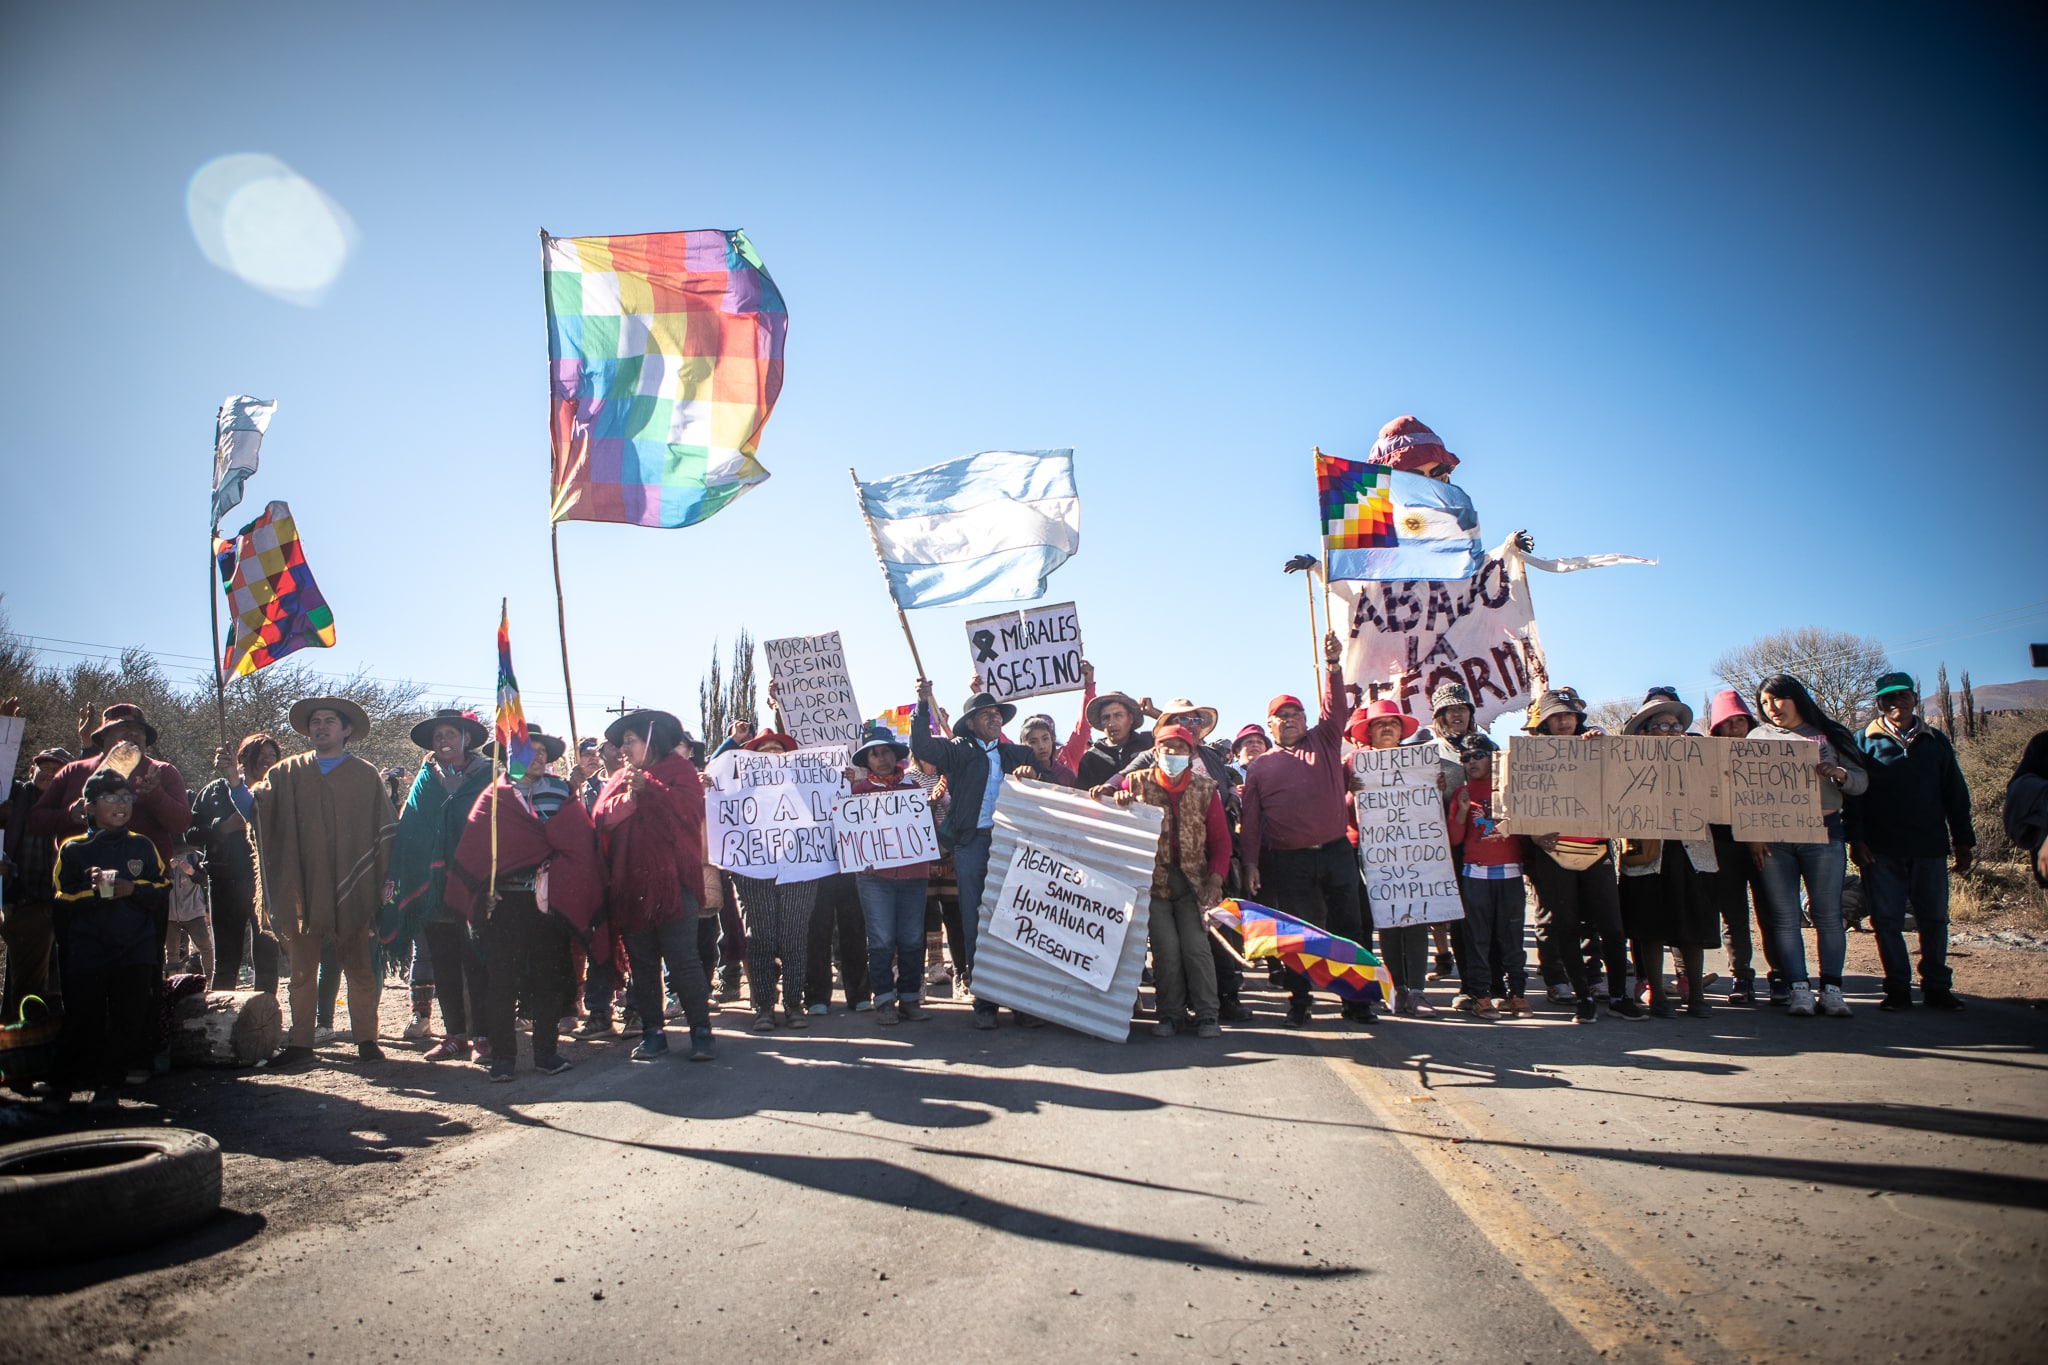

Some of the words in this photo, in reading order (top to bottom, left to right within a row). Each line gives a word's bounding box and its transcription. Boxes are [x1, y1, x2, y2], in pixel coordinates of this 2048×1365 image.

[1000, 614, 1077, 652] MORALES
[767, 634, 842, 660] MORALES
[773, 653, 842, 678] ASESINO
[986, 650, 1081, 696] ASESINO
[777, 672, 849, 695] HIPOCRITA
[781, 688, 851, 712] LADRÓN
[788, 707, 848, 728] LACRA
[779, 752, 792, 769] DE
[1355, 744, 1441, 773] QUEREMOS
[1515, 738, 1601, 762] PRESENTE
[1609, 738, 1703, 766] RENUNCIA
[1730, 741, 1770, 757] ABAJO
[1779, 741, 1795, 757] LA
[1381, 770, 1405, 787] LA
[1511, 762, 1578, 772] COMUNIDAD
[1732, 759, 1817, 792] REFORMA
[708, 776, 725, 792] AL
[741, 769, 784, 788] PUEBLO
[1512, 773, 1559, 793] NEGRA
[719, 796, 758, 826] NO
[774, 794, 799, 821] A
[843, 794, 925, 824] GRACIAS
[1513, 794, 1590, 818] MUERTA
[1780, 792, 1809, 805] LOS
[1387, 808, 1409, 823] DE
[1607, 804, 1705, 833] MORALES
[1361, 822, 1443, 843] MORALES
[1017, 846, 1082, 885] AGENTES
[1366, 847, 1397, 864] CON
[1400, 845, 1447, 862] TODO
[1380, 863, 1420, 881] SUS
[1370, 880, 1460, 900] COMPLICES
[1045, 881, 1124, 924] SANITARIOS
[1013, 885, 1105, 945] HUMAHUACA
